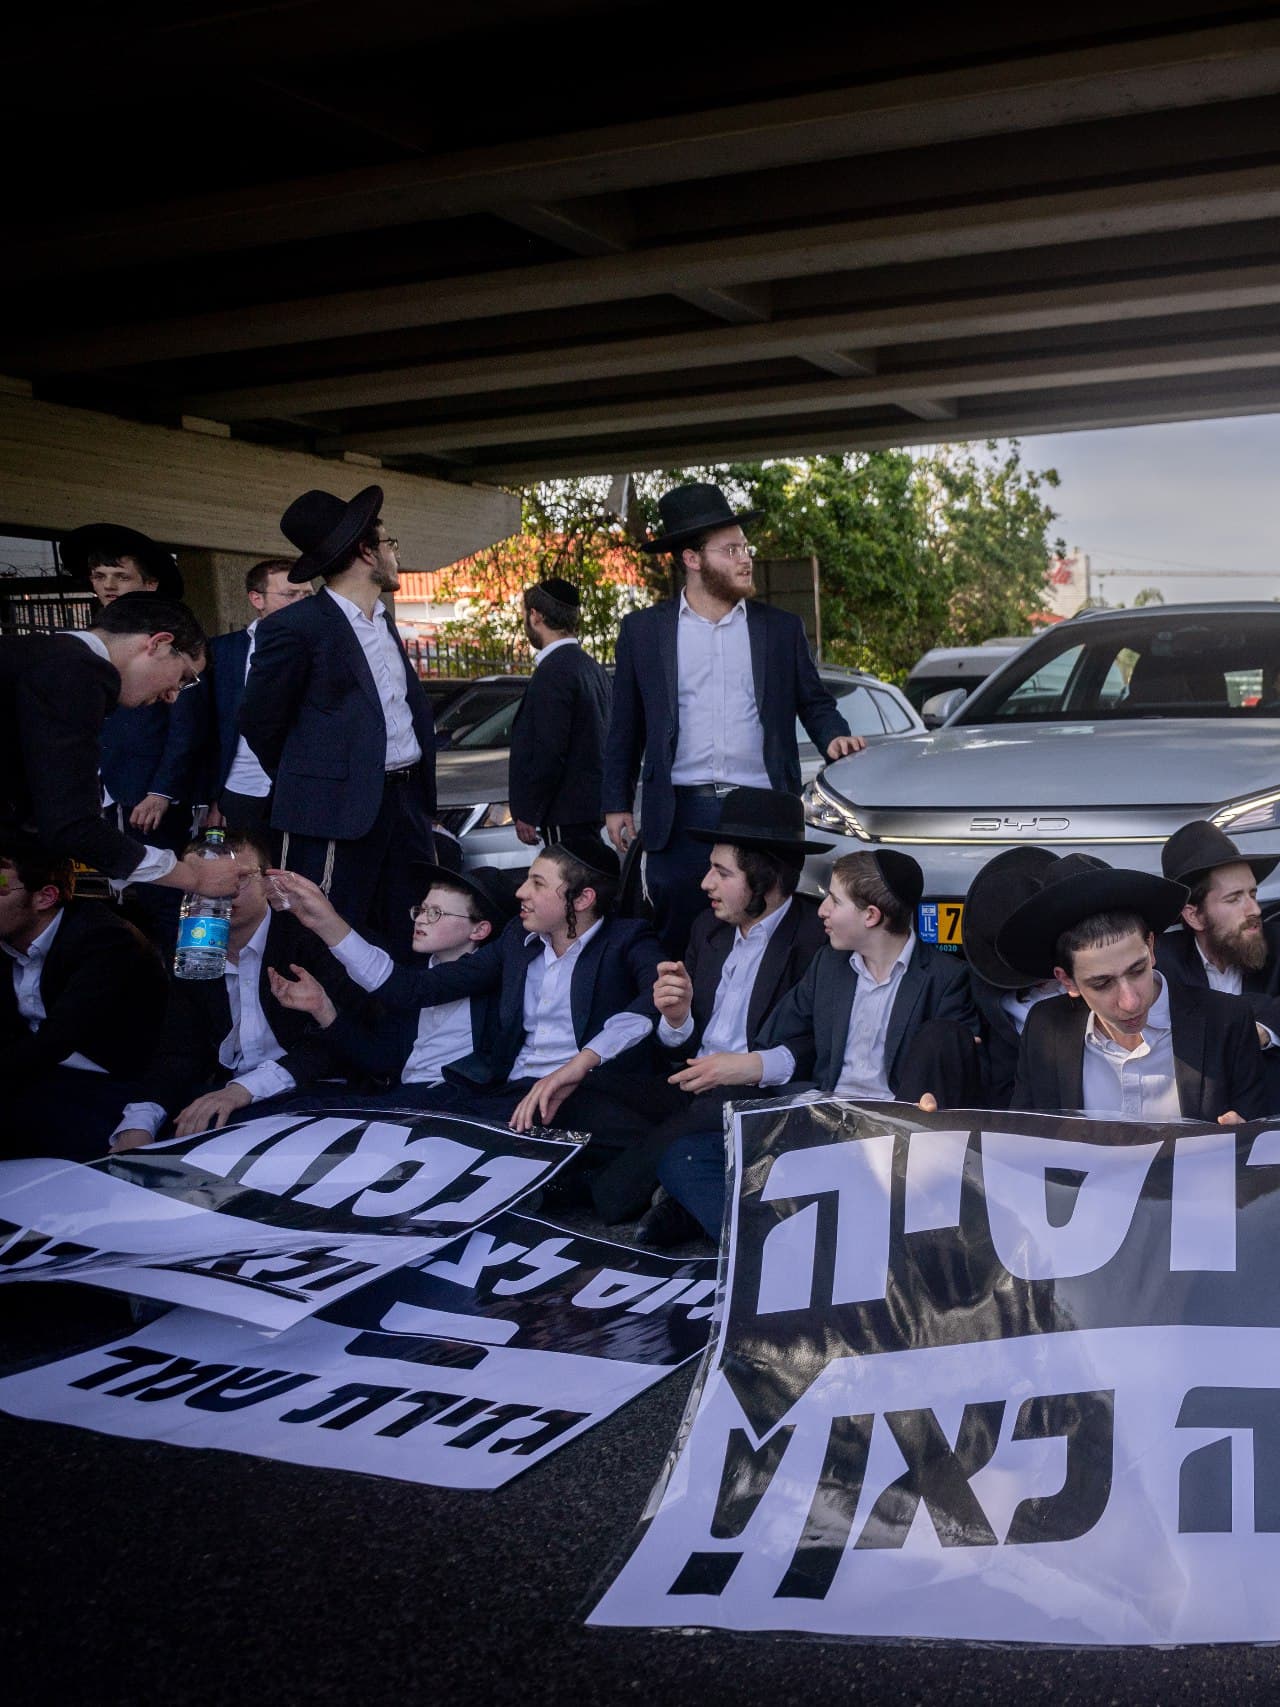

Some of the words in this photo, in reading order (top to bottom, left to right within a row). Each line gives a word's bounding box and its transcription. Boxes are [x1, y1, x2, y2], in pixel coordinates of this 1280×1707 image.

[970, 817, 1070, 832] BYD
[924, 916, 935, 932] IL
[67, 1346, 321, 1412] שמד
[279, 1382, 593, 1455] גזירת
